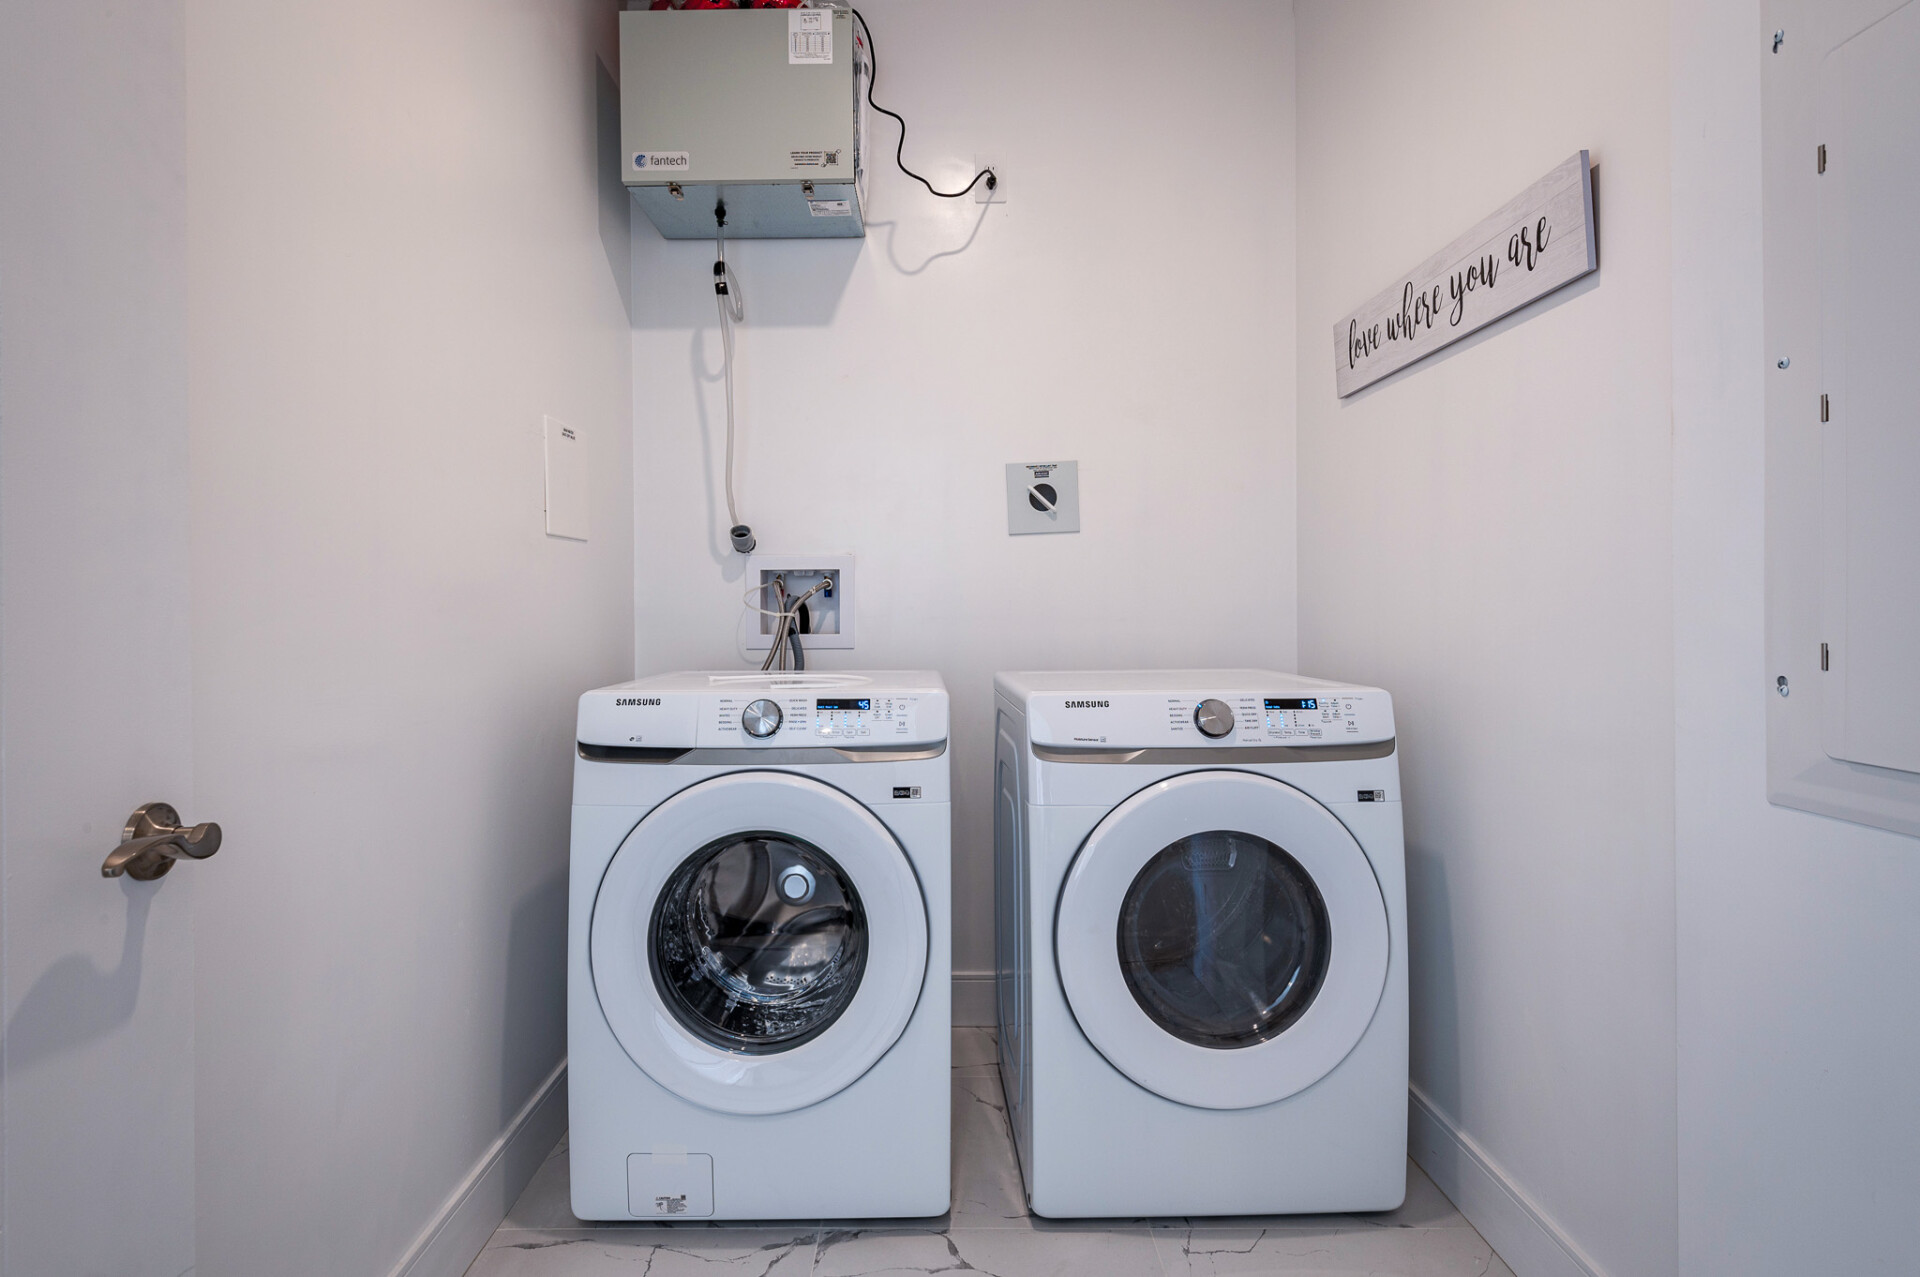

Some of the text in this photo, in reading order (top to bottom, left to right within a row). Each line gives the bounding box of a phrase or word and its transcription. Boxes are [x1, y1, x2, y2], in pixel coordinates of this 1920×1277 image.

[650, 155, 687, 165] fantech
[1348, 216, 1552, 370] love where you are
[858, 700, 869, 710] 45
